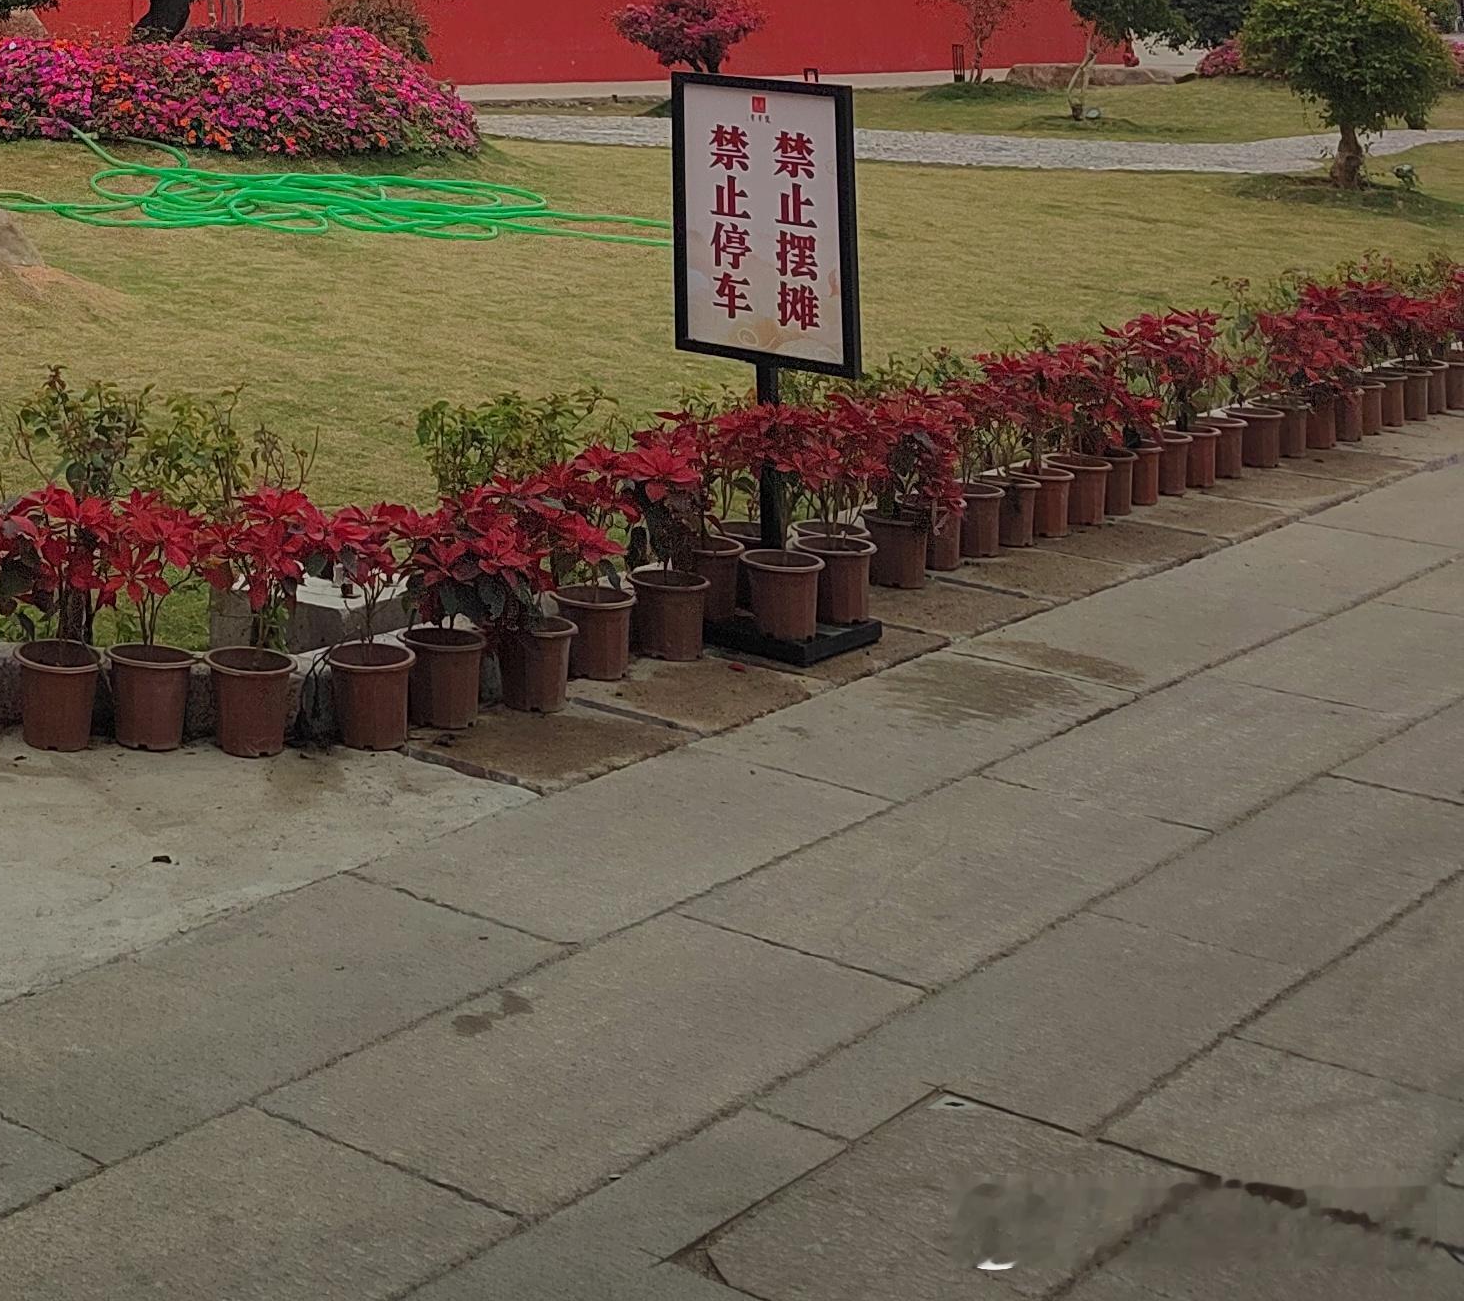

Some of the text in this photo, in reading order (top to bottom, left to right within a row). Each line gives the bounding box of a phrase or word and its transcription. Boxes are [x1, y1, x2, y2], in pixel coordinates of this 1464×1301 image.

[710, 124, 753, 319] 禁止停车
[773, 130, 821, 330] 禁止摆摊
